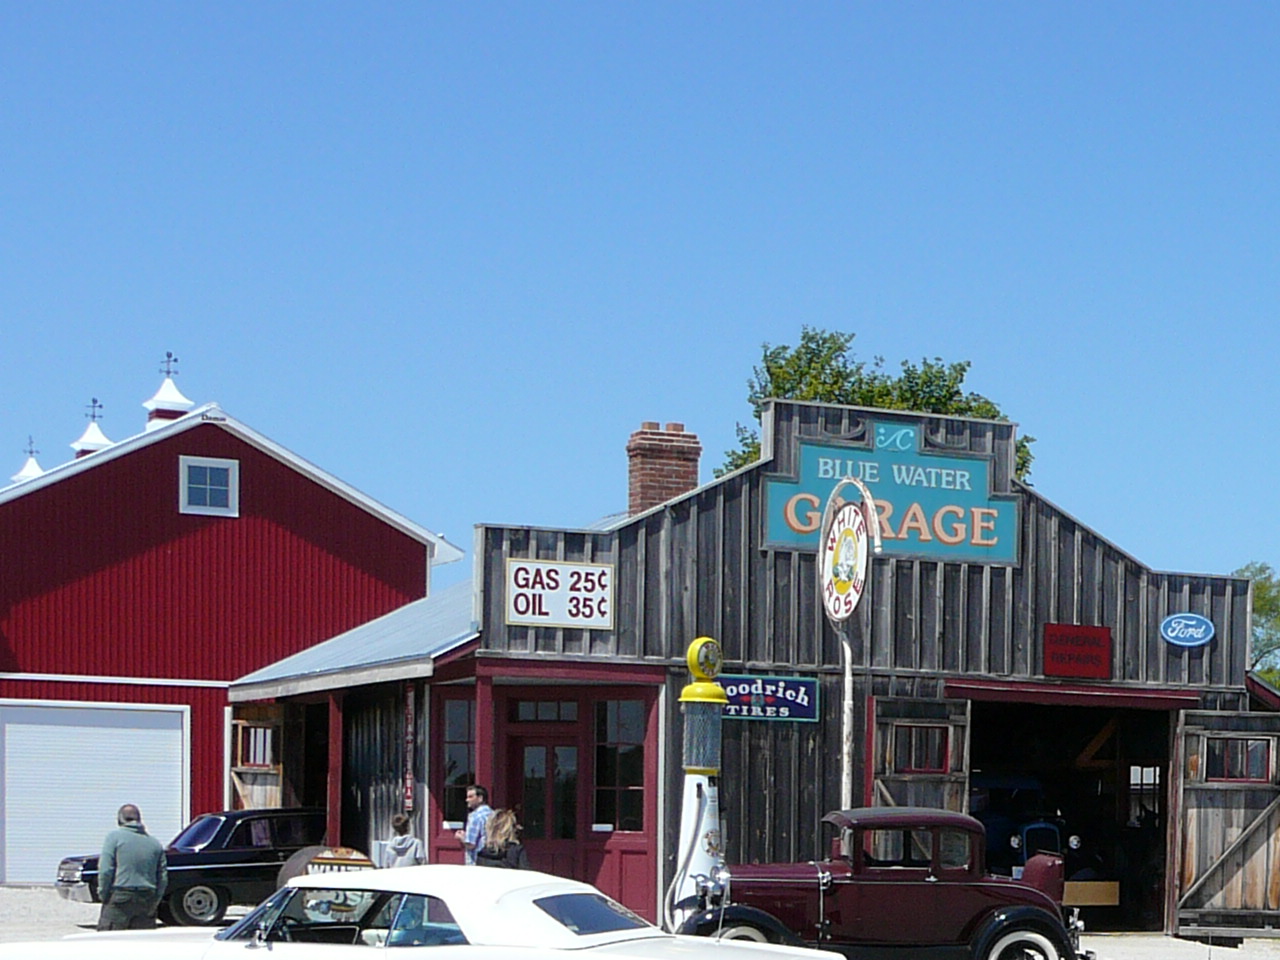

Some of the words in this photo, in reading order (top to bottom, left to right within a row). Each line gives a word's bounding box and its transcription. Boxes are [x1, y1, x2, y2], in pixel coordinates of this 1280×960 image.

[818, 458, 880, 483] BLUE
[892, 464, 972, 491] WATER
[784, 493, 999, 547] GRAGE
[828, 507, 866, 552] WHITE
[513, 567, 560, 590] GAS
[569, 570, 608, 593] 25¢
[826, 571, 863, 614] ROSE
[513, 593, 550, 616] OIL
[567, 596, 607, 618] 35¢
[1167, 618, 1206, 638] Ford
[714, 679, 809, 706] oodrich
[726, 705, 789, 717] TIRES
